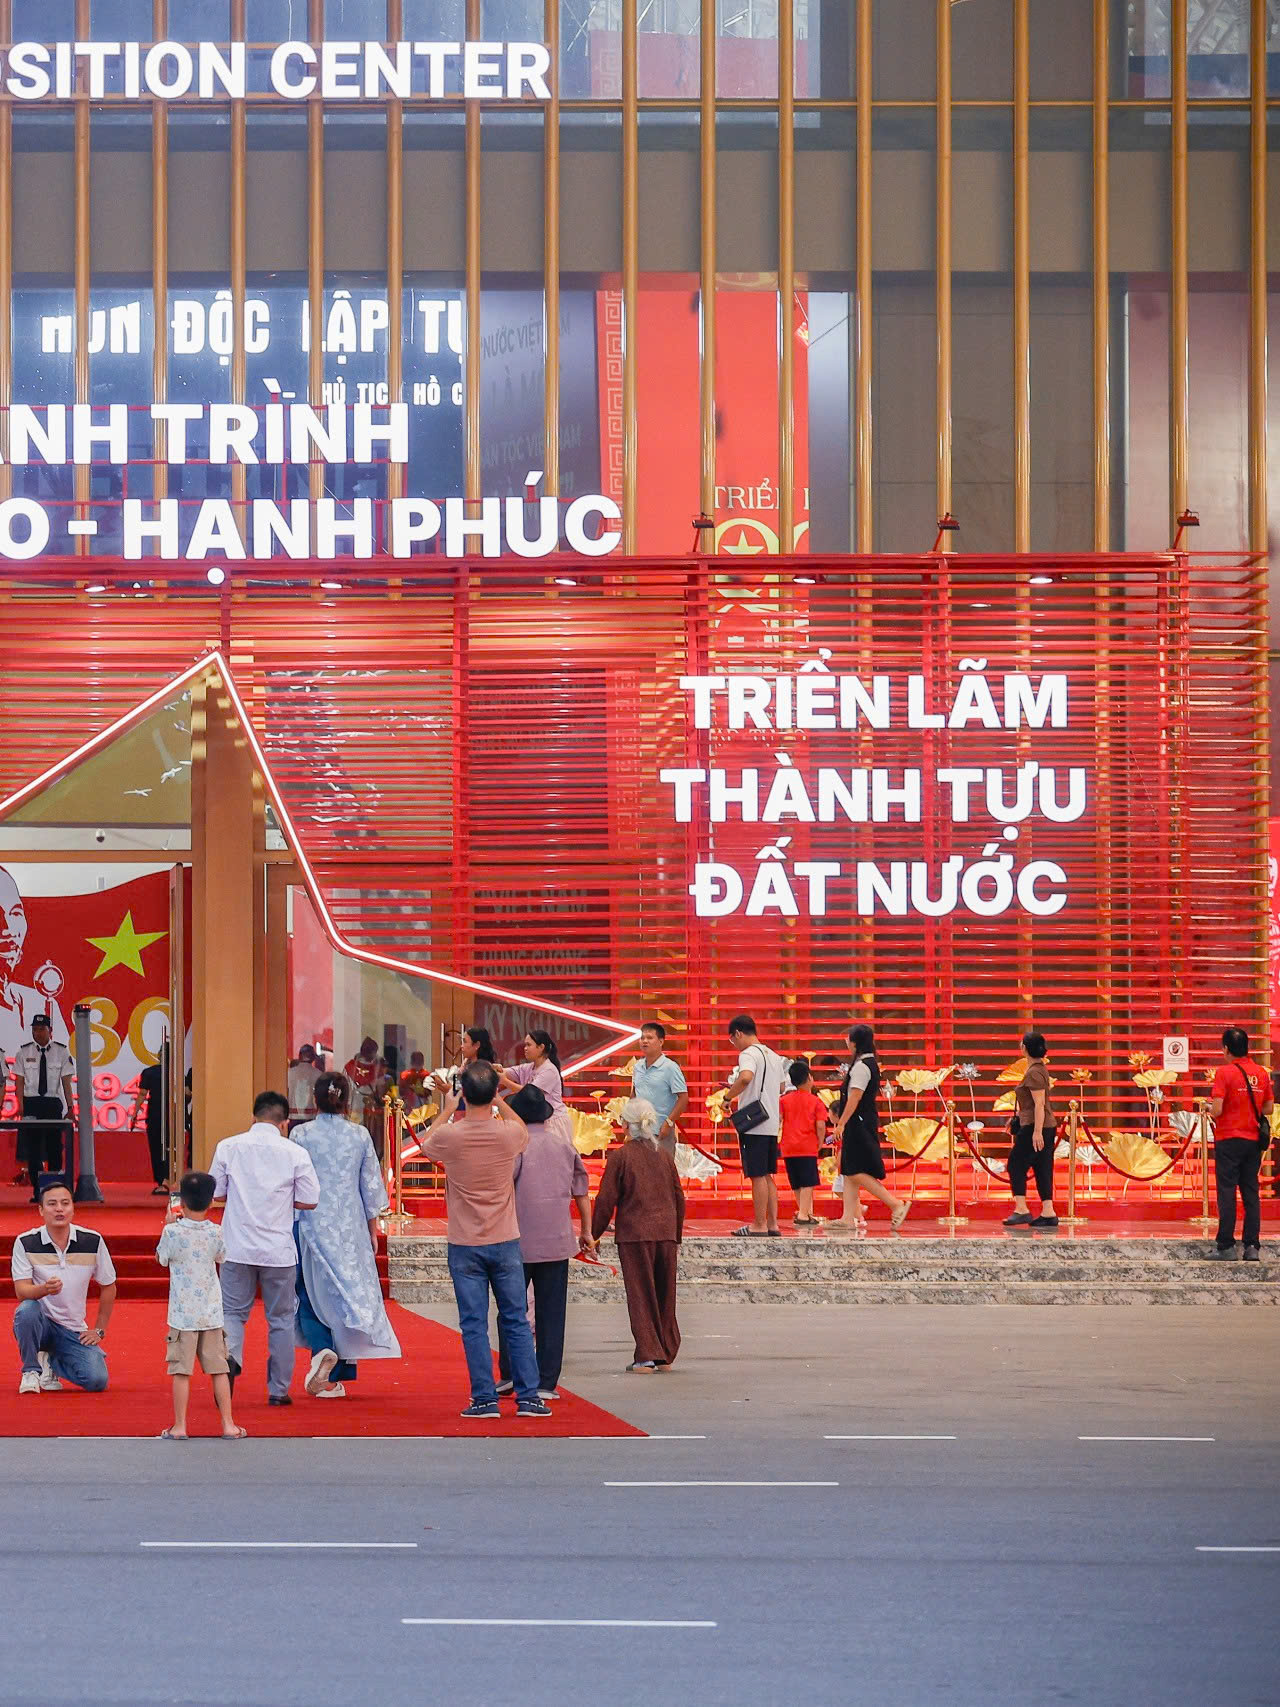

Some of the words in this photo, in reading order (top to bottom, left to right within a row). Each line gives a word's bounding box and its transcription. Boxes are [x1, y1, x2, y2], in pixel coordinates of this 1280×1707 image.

[270, 41, 552, 99] CENTER
[170, 290, 270, 366] ĐỘC
[150, 377, 409, 465] TRÌNH
[67, 520, 98, 535] -
[123, 497, 373, 585] HẠNH
[392, 471, 621, 559] PHÚC
[714, 477, 780, 510] TRIỂ
[679, 648, 890, 729] TRIỂN
[908, 658, 1068, 729] LÃM
[659, 753, 921, 822] THÀNH
[937, 760, 1086, 841] TỰU
[688, 834, 841, 917] ĐẤT
[857, 842, 1068, 917] NƯỚC
[68, 995, 171, 1068] 80
